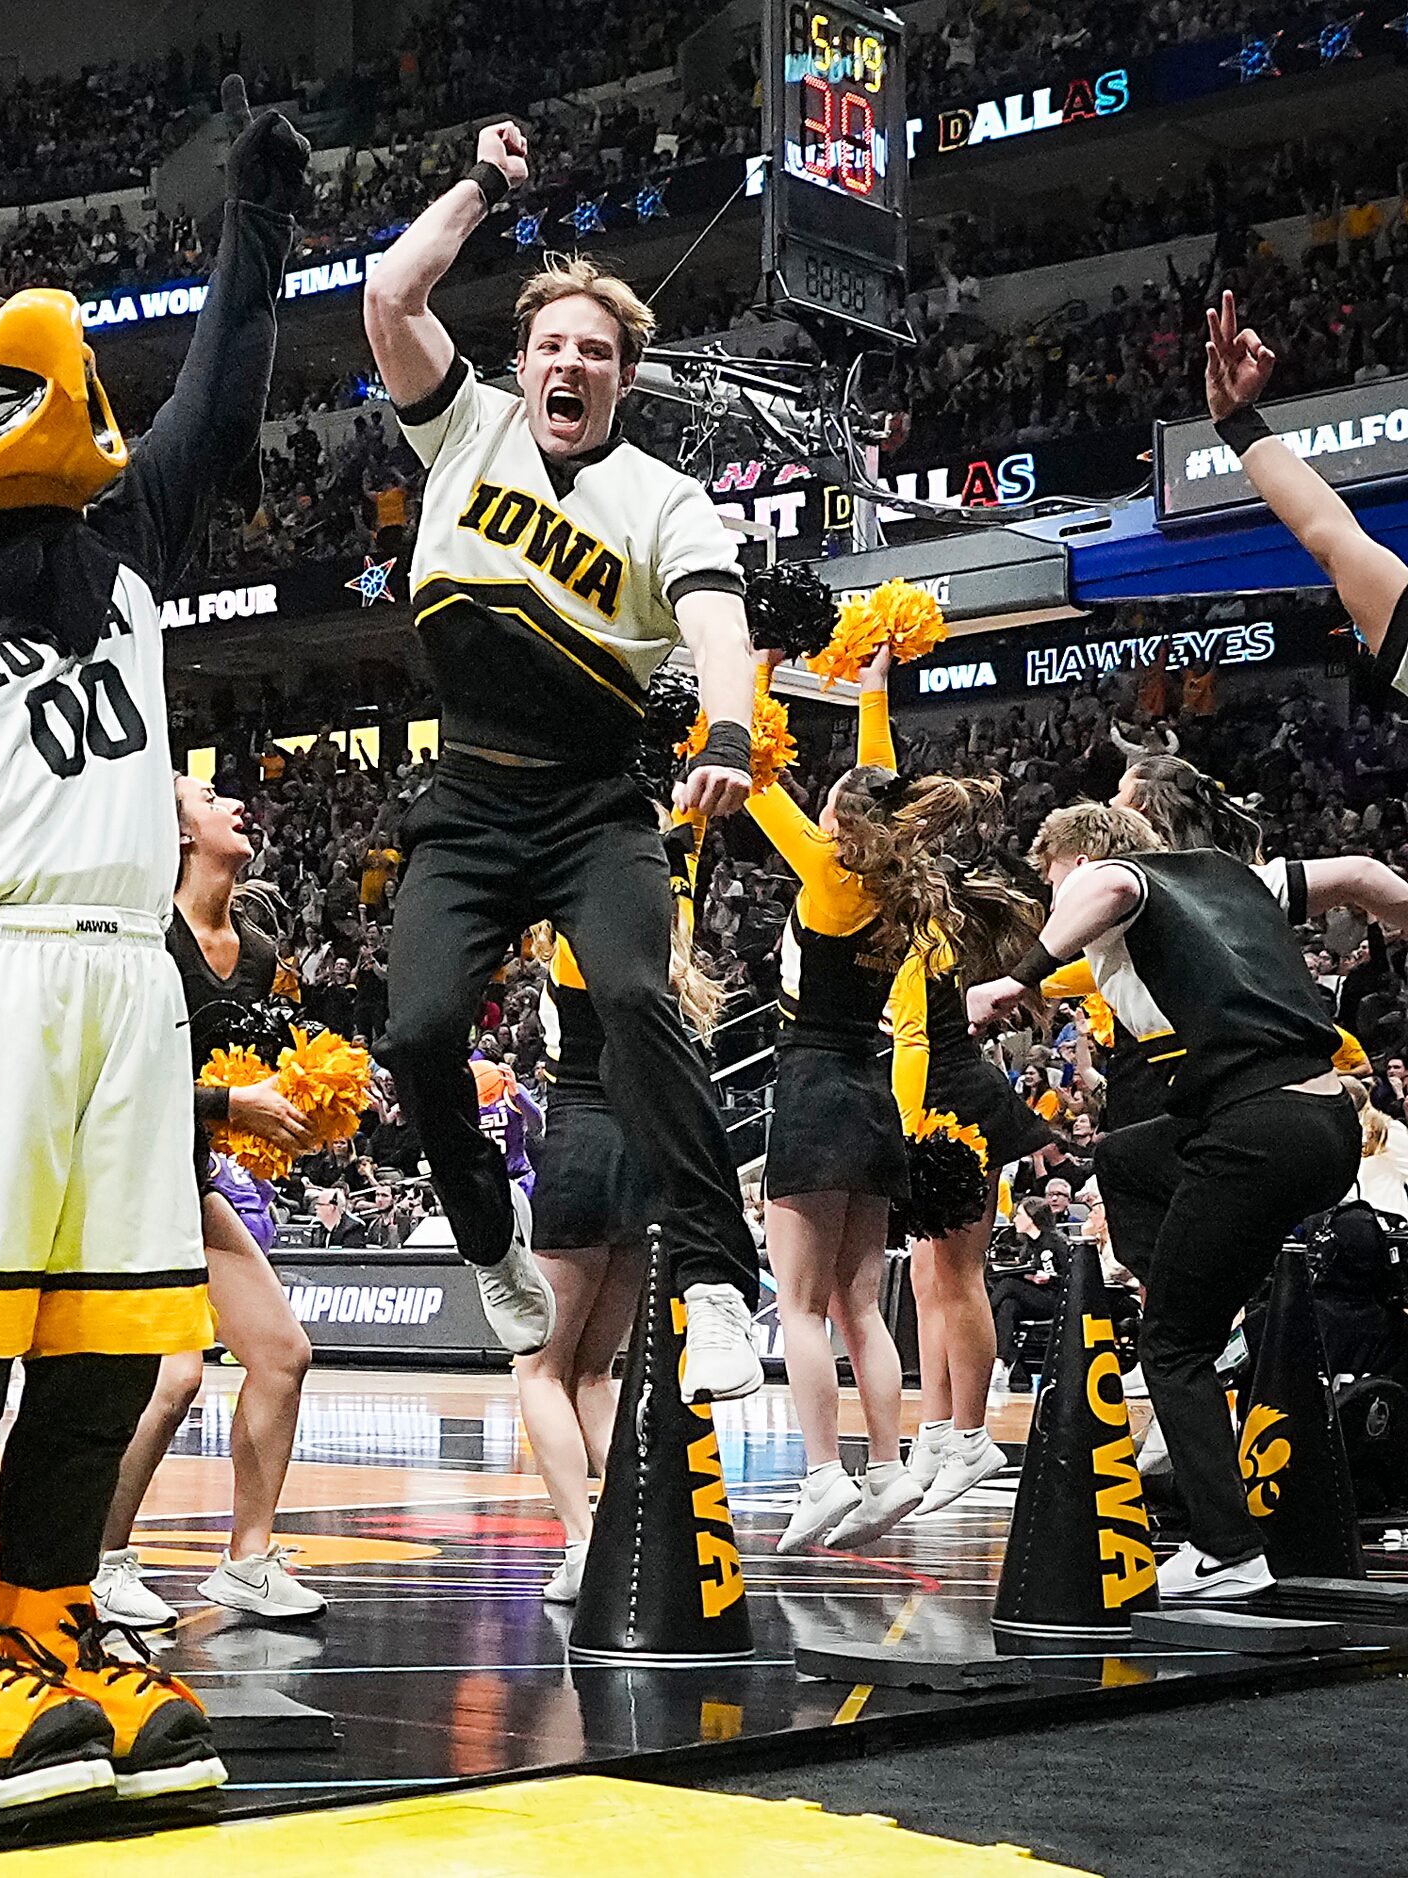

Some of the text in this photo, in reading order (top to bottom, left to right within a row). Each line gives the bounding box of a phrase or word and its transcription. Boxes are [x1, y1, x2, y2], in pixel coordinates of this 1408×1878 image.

[811, 14, 882, 92] 5:19
[803, 74, 872, 195] 30
[938, 69, 1129, 152] DALLAS
[80, 297, 138, 328] CAA
[285, 258, 362, 298] FINAL
[457, 480, 627, 621] IOWA
[198, 584, 278, 623] FOUR
[919, 621, 1275, 693] IOWA HAWKEYES
[24, 659, 148, 780] 00
[75, 919, 118, 933] HAWKS
[478, 1112, 509, 1129] SU
[282, 1286, 444, 1324] MPIONSHIP
[1082, 1313, 1158, 1609] IOWA
